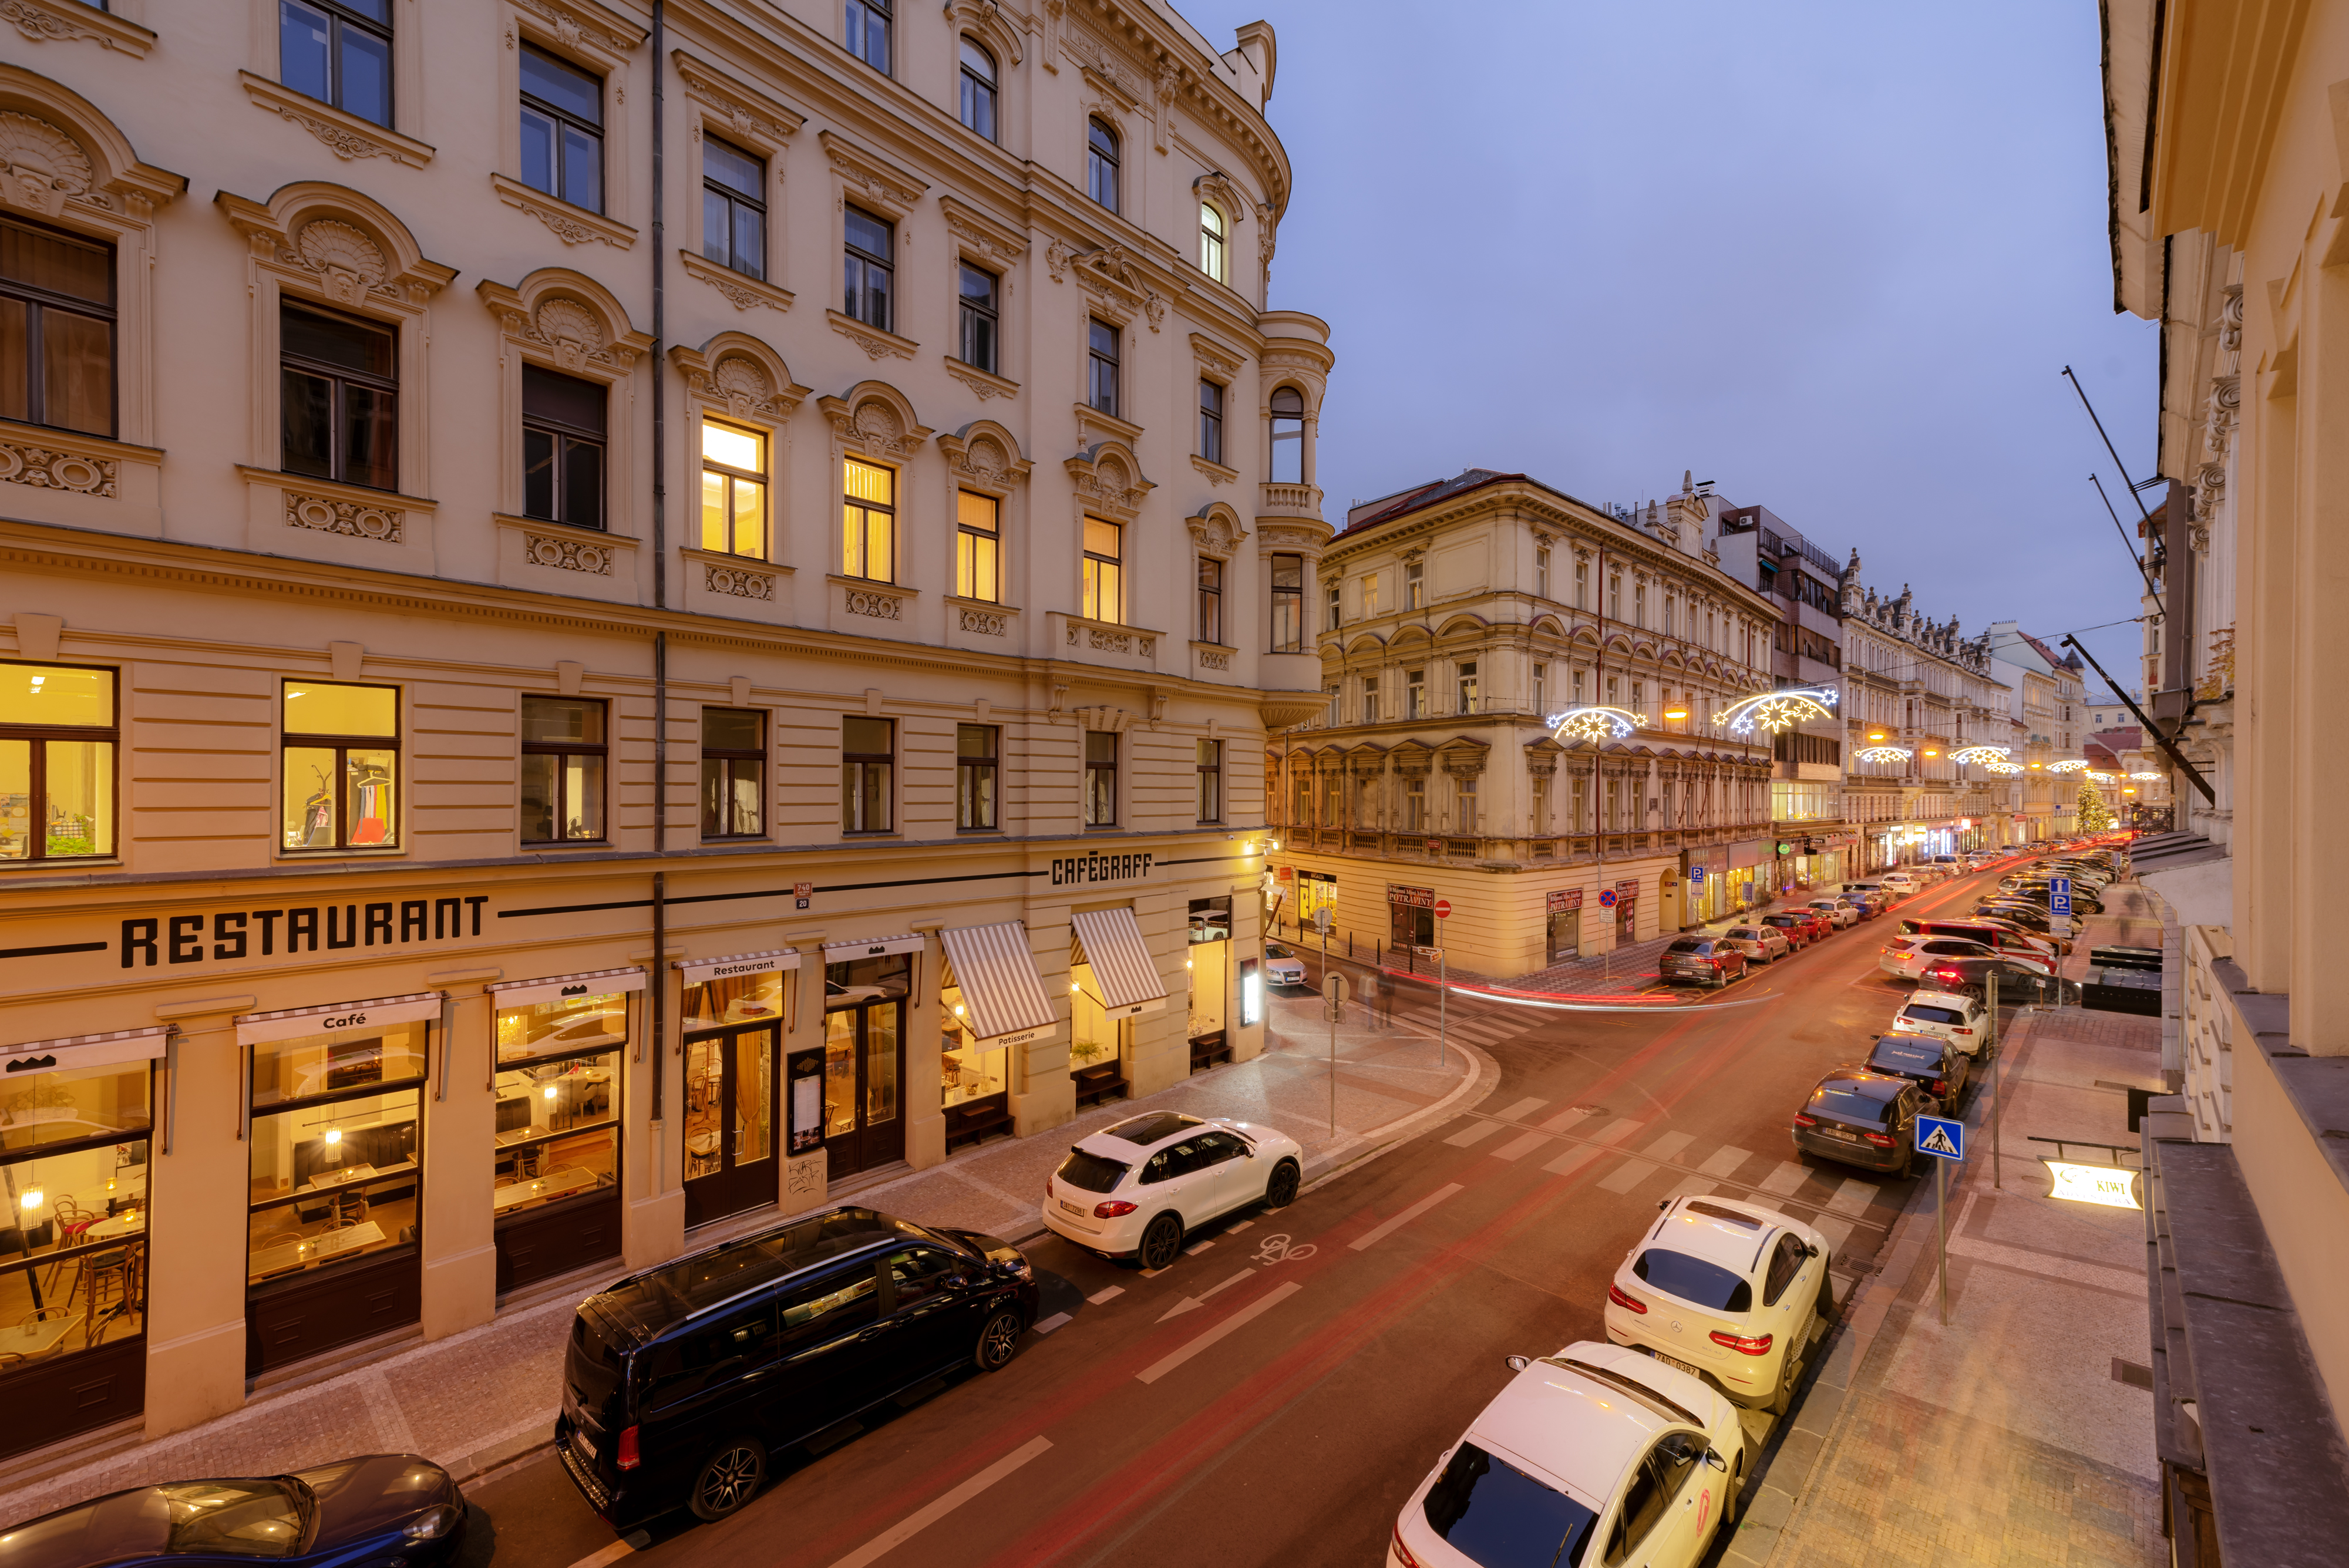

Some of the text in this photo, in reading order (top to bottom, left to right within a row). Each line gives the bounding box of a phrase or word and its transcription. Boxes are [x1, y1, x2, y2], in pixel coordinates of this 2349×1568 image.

[1389, 893, 1432, 906] POTRAVINY
[1618, 889, 1638, 897] POTRAVINY
[1550, 899, 1581, 911] POTRAVINY
[121, 896, 489, 968] RESTAURANT
[714, 960, 775, 975] Restaurant
[323, 1013, 366, 1028] Café
[999, 1031, 1035, 1045] Patisserie
[2096, 1180, 2125, 1194] KIWI
[1072, 1205, 1082, 1214] 7298
[1656, 1353, 1696, 1375] 7AD 0387
